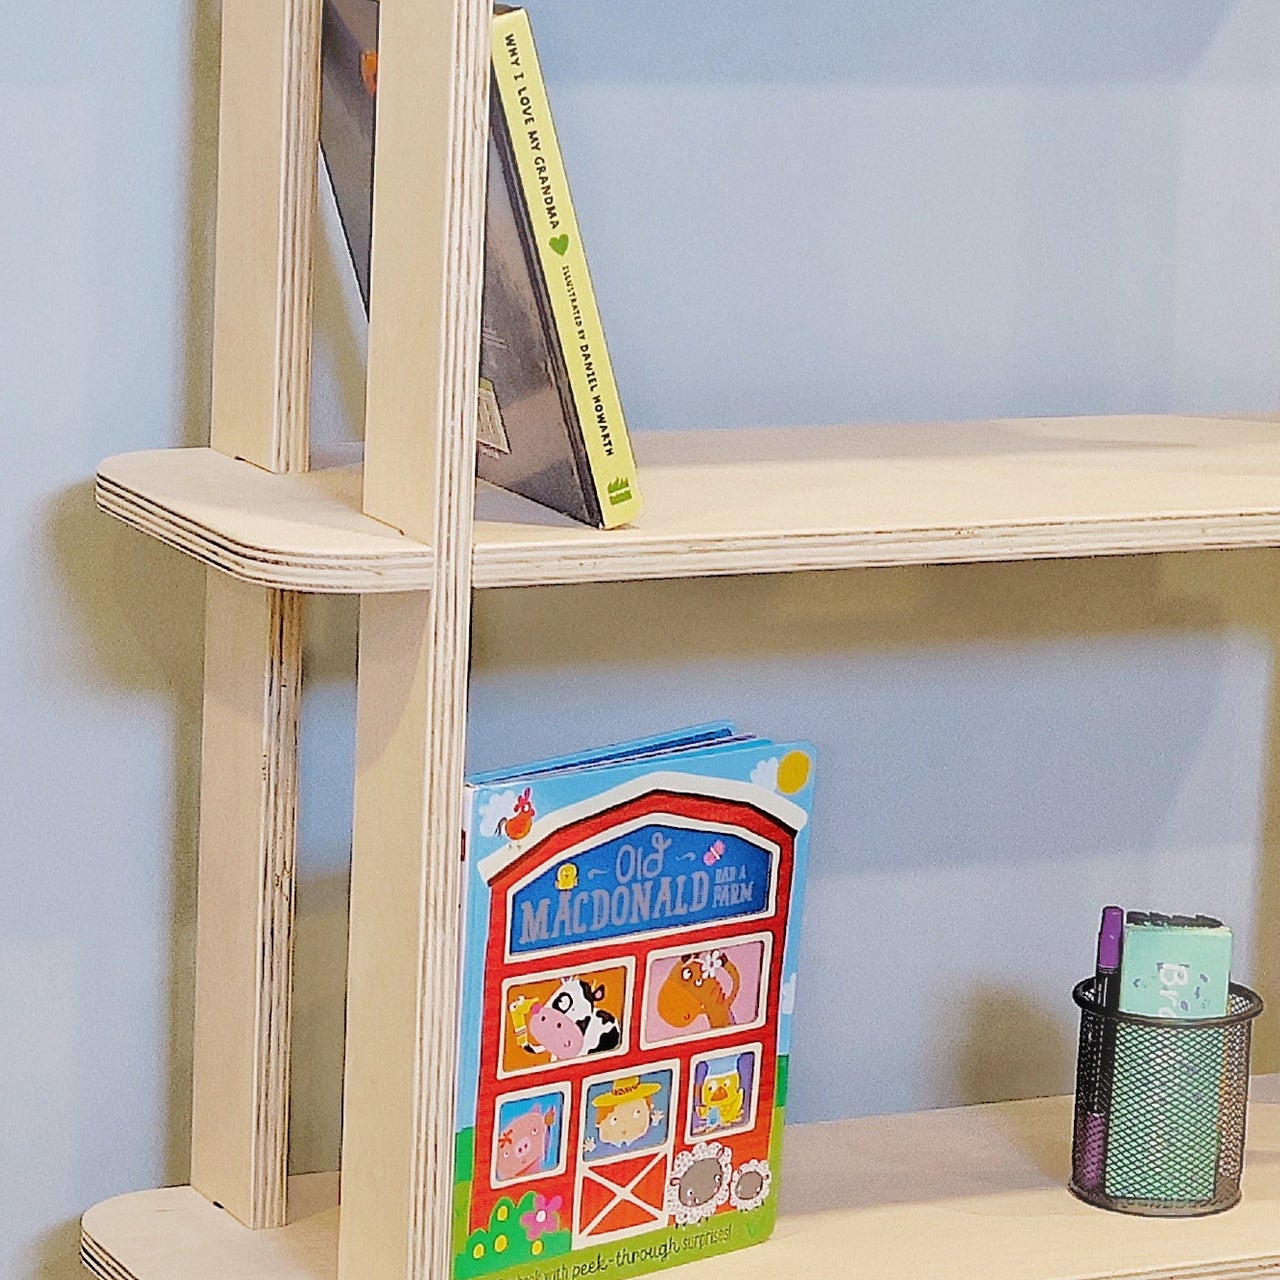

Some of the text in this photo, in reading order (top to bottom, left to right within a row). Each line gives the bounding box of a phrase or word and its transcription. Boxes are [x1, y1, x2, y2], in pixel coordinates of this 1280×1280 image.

[505, 33, 559, 229] WHY I LOVE MY GRANDMA
[562, 265, 614, 456] ILLUSTRATED BY DANIEL HOWARTH
[519, 870, 710, 945] MACDONALD
[615, 831, 672, 884] Old
